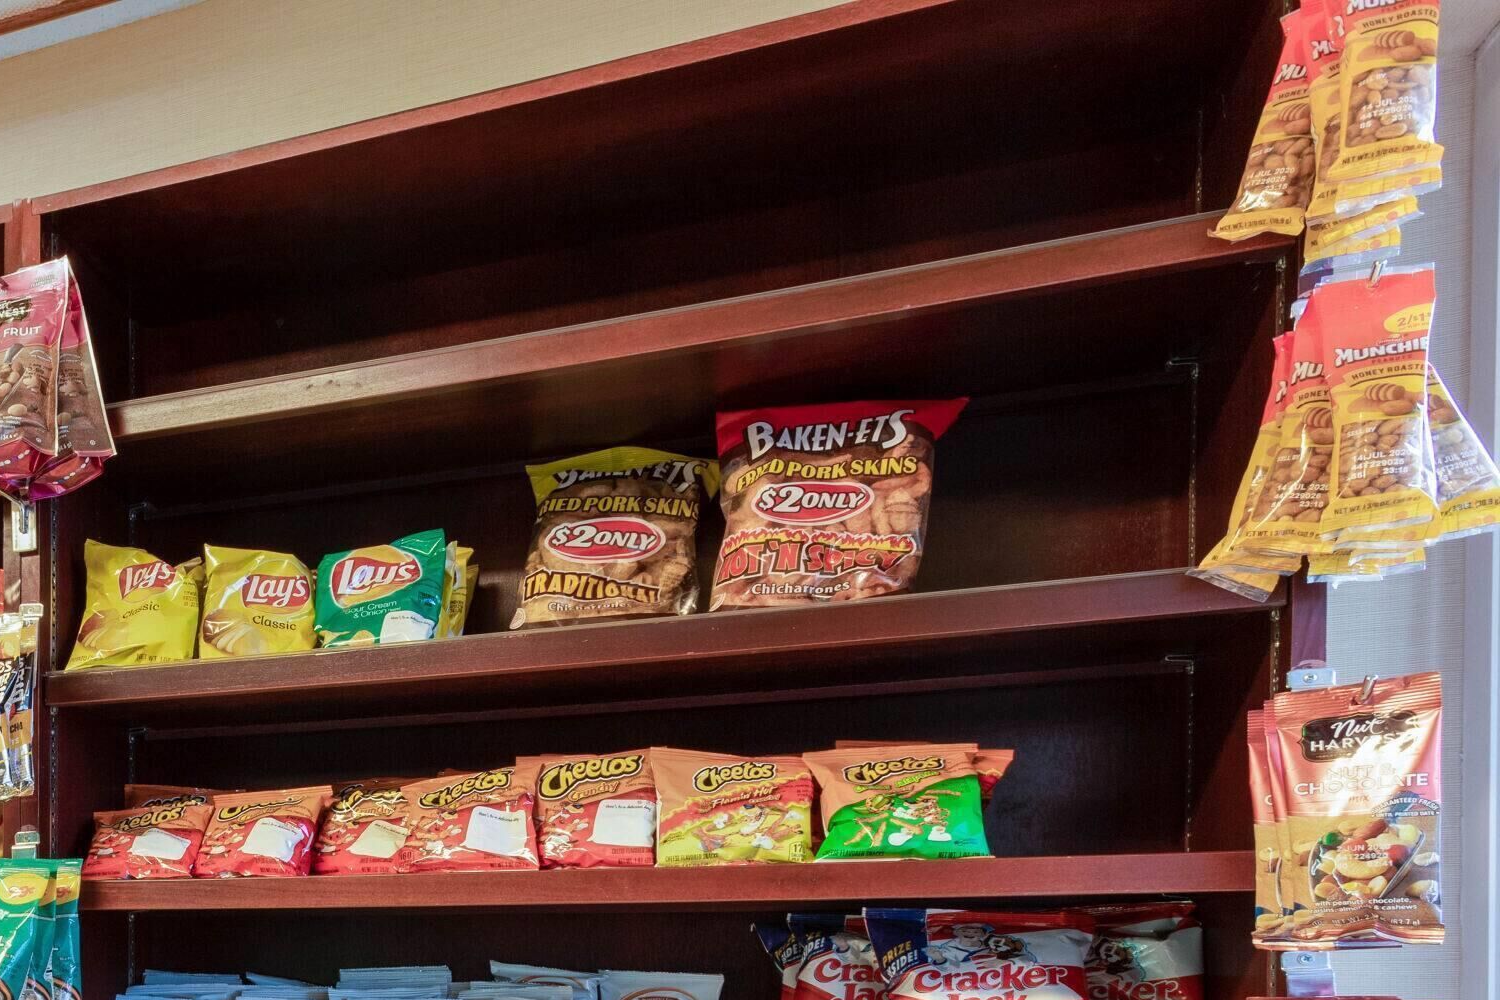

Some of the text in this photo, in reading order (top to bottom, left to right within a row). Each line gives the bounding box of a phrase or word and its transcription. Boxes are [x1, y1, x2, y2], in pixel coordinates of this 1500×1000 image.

[1362, 15, 1394, 28] HONEY
[2, 325, 43, 339] FRUIT
[1351, 367, 1384, 381] HONEY
[747, 409, 915, 462] BAKEN-ETS
[736, 456, 918, 493] FRIED PORK SKINS
[583, 496, 641, 513] PORK
[806, 544, 907, 574] SPICY
[336, 559, 417, 595] Lay's
[525, 570, 660, 604] TRADITIONAL
[751, 581, 851, 596] Chicharrones
[246, 575, 308, 608] Lay's
[122, 601, 161, 619] Classic
[361, 608, 388, 618] Onion
[367, 600, 398, 611] Cream
[252, 614, 297, 631] Classic
[1331, 717, 1386, 739] Nut
[538, 754, 644, 800] Cheetos
[692, 761, 777, 793] Cheetos
[842, 756, 946, 786] Cheetos
[418, 768, 516, 809] Cheetos
[567, 781, 621, 802] Crunchy
[711, 785, 777, 809] Flamin' Hot
[882, 940, 912, 965] PRIZE
[912, 962, 1069, 994] Cracker
